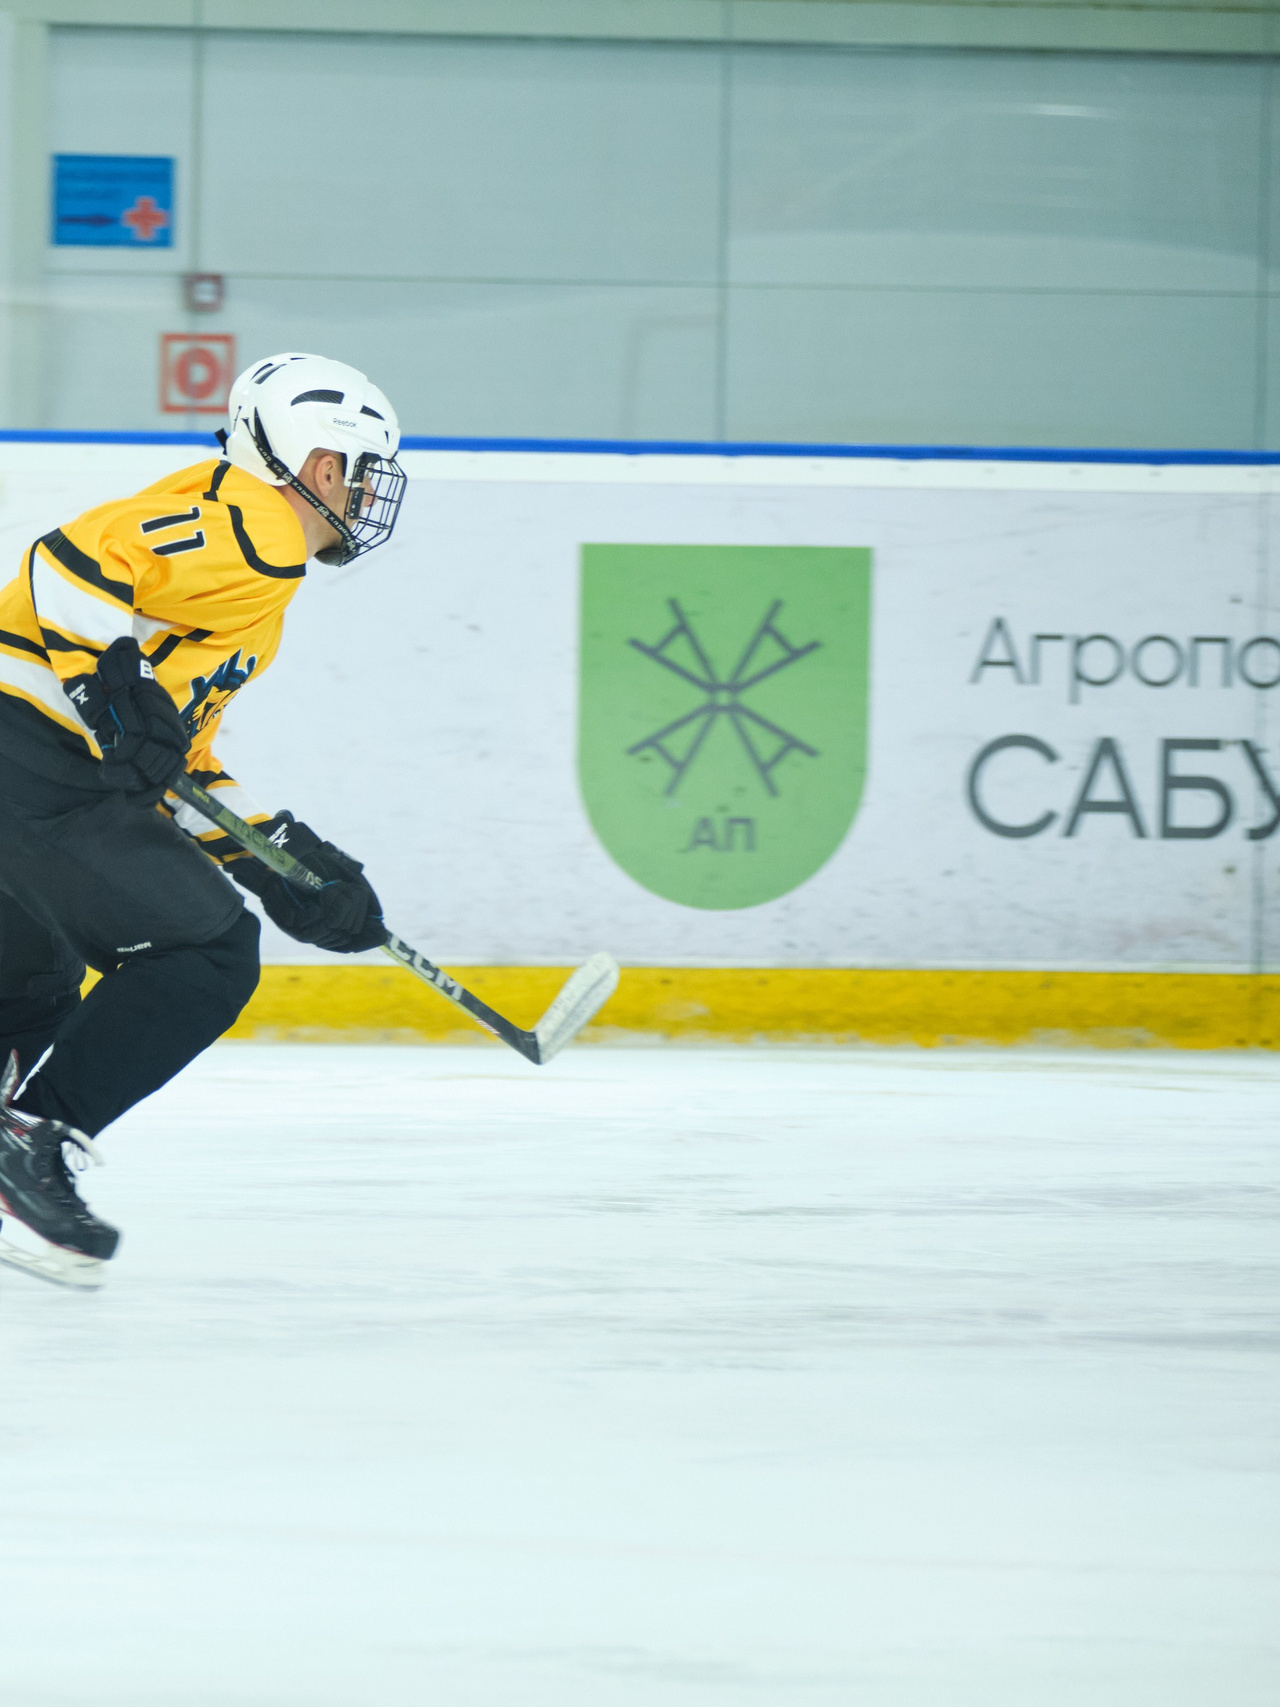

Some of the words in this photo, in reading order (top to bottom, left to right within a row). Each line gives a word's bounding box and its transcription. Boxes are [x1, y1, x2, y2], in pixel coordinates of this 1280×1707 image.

[139, 505, 206, 557] 11
[687, 816, 757, 853] АП
[389, 933, 464, 1001] CCM
